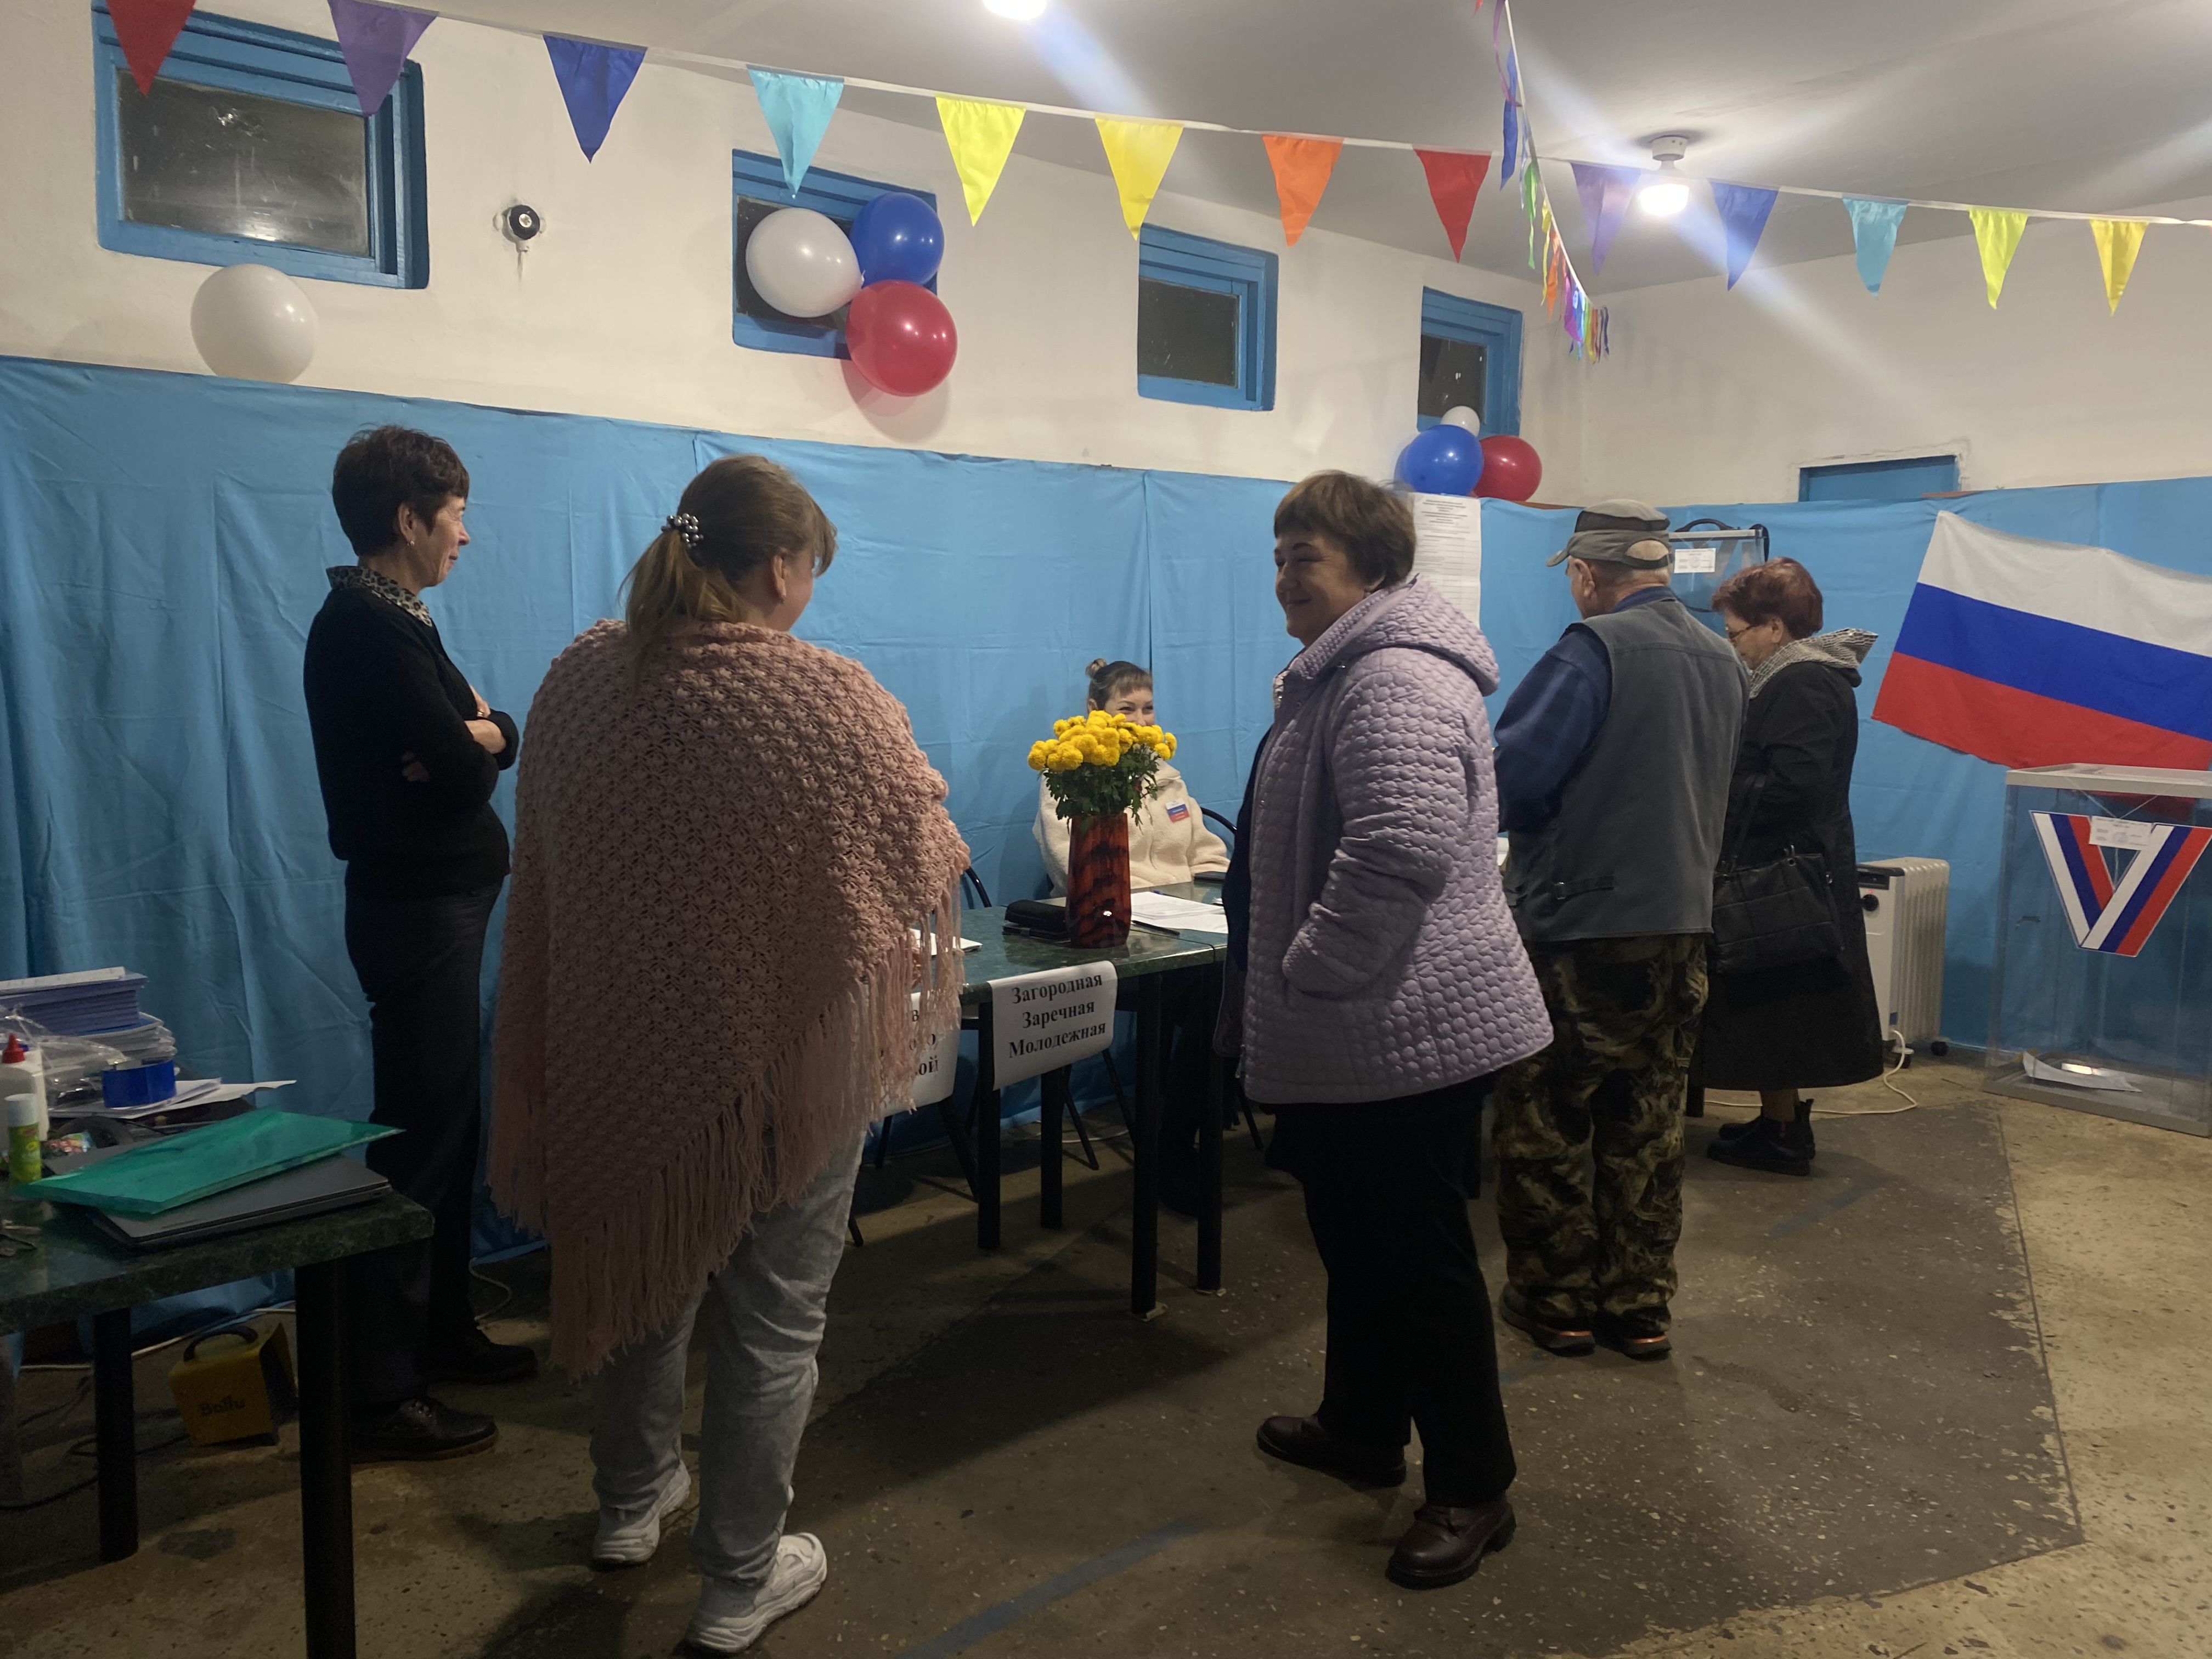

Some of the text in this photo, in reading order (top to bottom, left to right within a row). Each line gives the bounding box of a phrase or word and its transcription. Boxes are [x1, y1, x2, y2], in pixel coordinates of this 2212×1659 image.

[1012, 975, 1103, 1004] Загородная
[1022, 1002, 1095, 1029] Заречная
[1009, 1023, 1106, 1058] Молодежная
